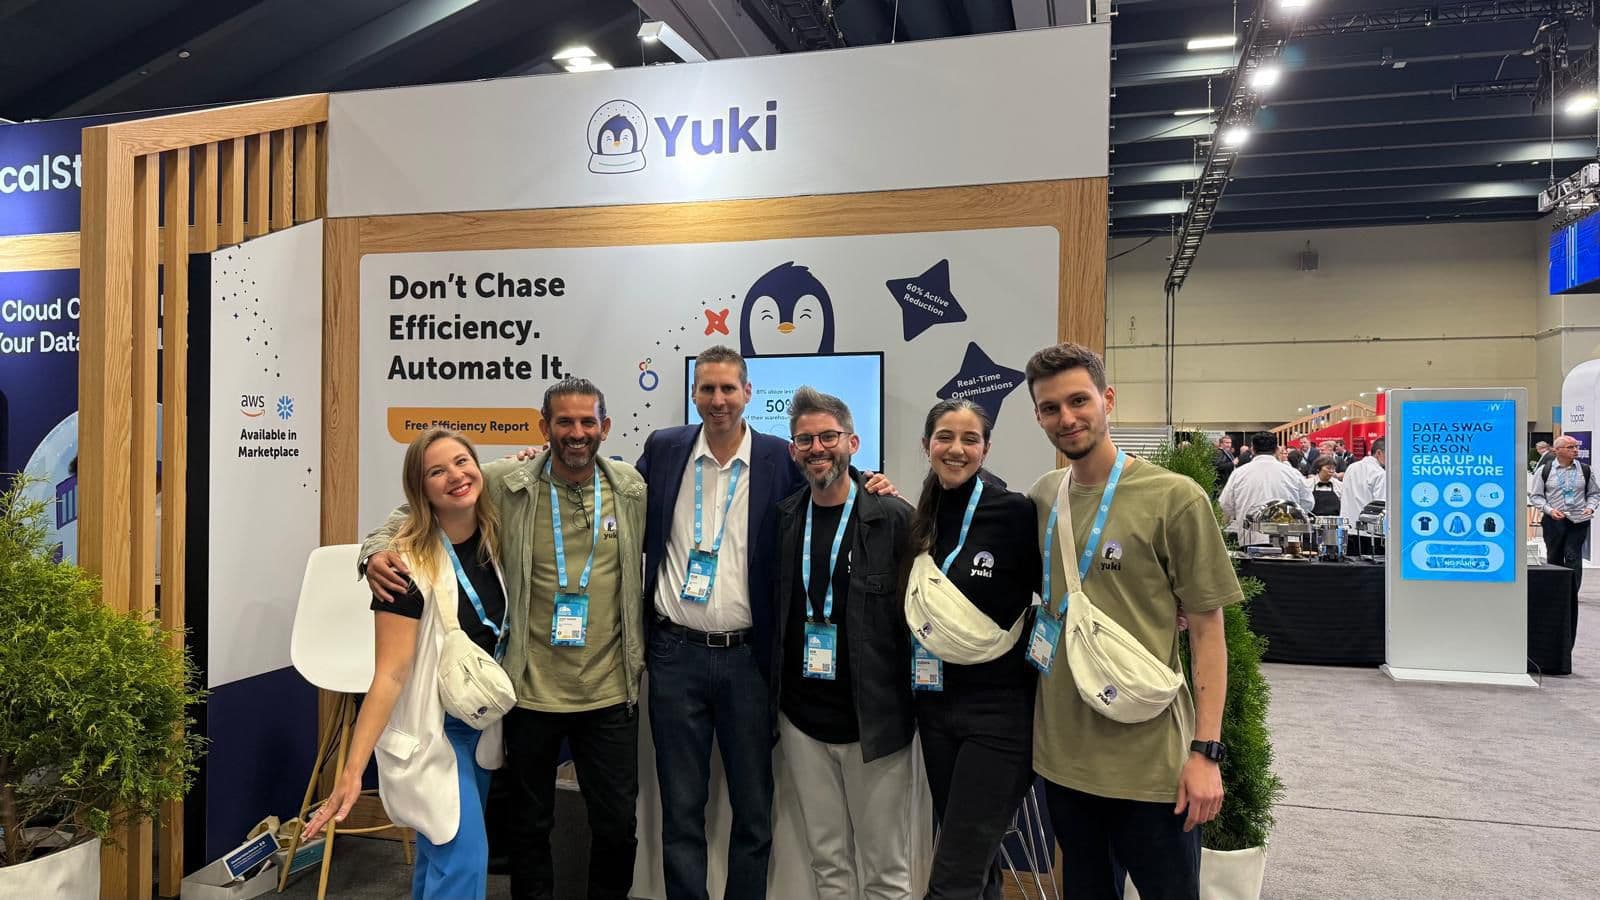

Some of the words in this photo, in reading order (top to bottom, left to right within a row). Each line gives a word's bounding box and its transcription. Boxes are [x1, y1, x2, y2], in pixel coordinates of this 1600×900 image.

[654, 100, 777, 157] Yuki
[0, 154, 81, 194] calSt
[389, 273, 467, 300] Don’t
[475, 272, 565, 298] Chase
[905, 283, 923, 296] 60%
[923, 291, 950, 307] Active
[2, 298, 62, 322] Cloud
[903, 293, 944, 317] Reduction
[389, 314, 540, 345] Efficiency.
[387, 355, 532, 380] Automate
[541, 354, 571, 380] It.
[957, 373, 1001, 388] Real-Time
[951, 381, 1014, 400] Optimizations
[241, 394, 265, 408] aws
[405, 420, 428, 431] Free
[490, 420, 529, 433] Report
[1412, 422, 1448, 432] DATA
[1451, 422, 1493, 432] SWAG
[240, 428, 286, 441] Available
[288, 428, 297, 441] in
[1412, 433, 1441, 443] FOR
[1445, 433, 1474, 443] ANY
[238, 445, 300, 460] Marketplace
[1412, 444, 1470, 454] SEASON
[1412, 455, 1451, 465] GEAR
[1455, 455, 1475, 465] UP
[1478, 455, 1494, 465] IN
[1412, 465, 1504, 476] SNOWSTORE
[970, 568, 992, 578] yuki
[1100, 562, 1121, 571] yuki
